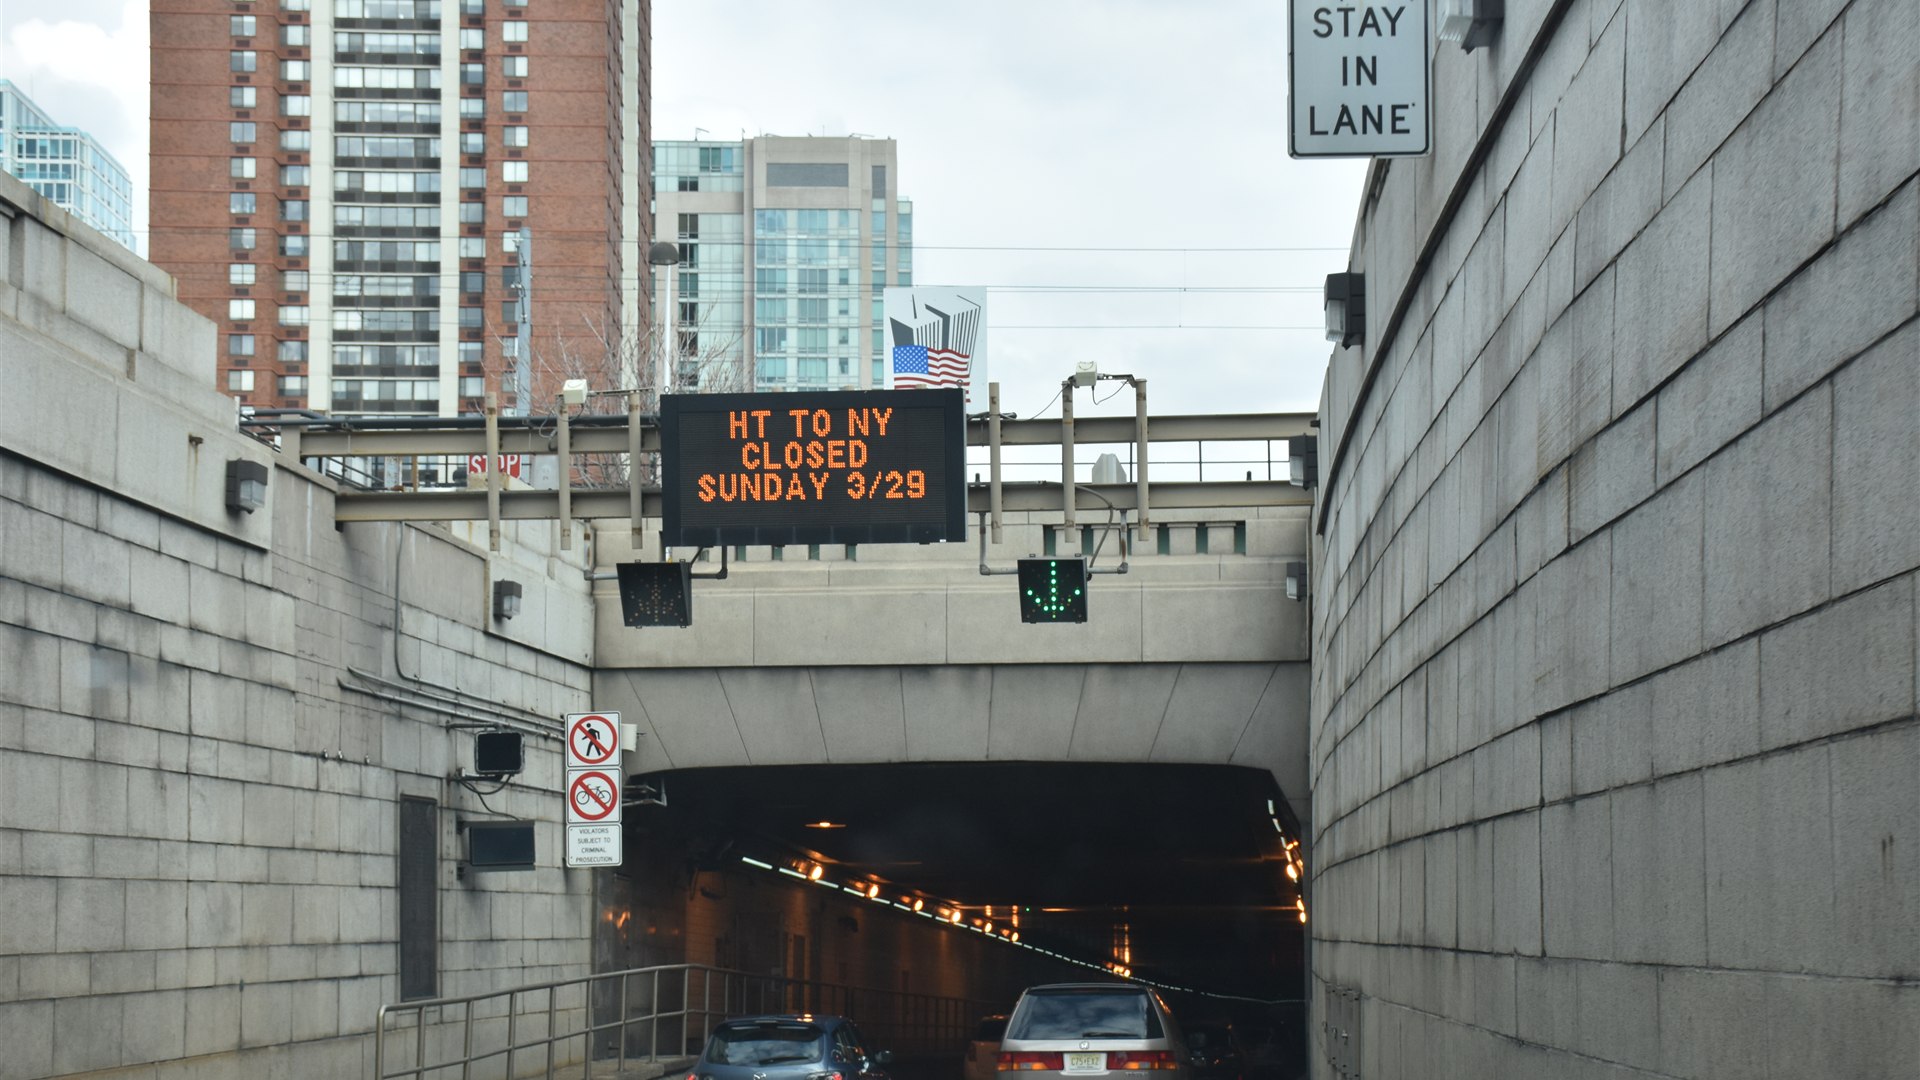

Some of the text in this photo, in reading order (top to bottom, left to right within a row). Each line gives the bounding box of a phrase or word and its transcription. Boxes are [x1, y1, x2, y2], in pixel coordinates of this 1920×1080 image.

[1312, 6, 1406, 39] STAY
[1342, 55, 1377, 86] IN
[1309, 104, 1411, 136] LANE
[729, 407, 893, 439] HT TO NY
[742, 439, 868, 470] CLOSED
[698, 470, 926, 502] SUNDAY 3/29
